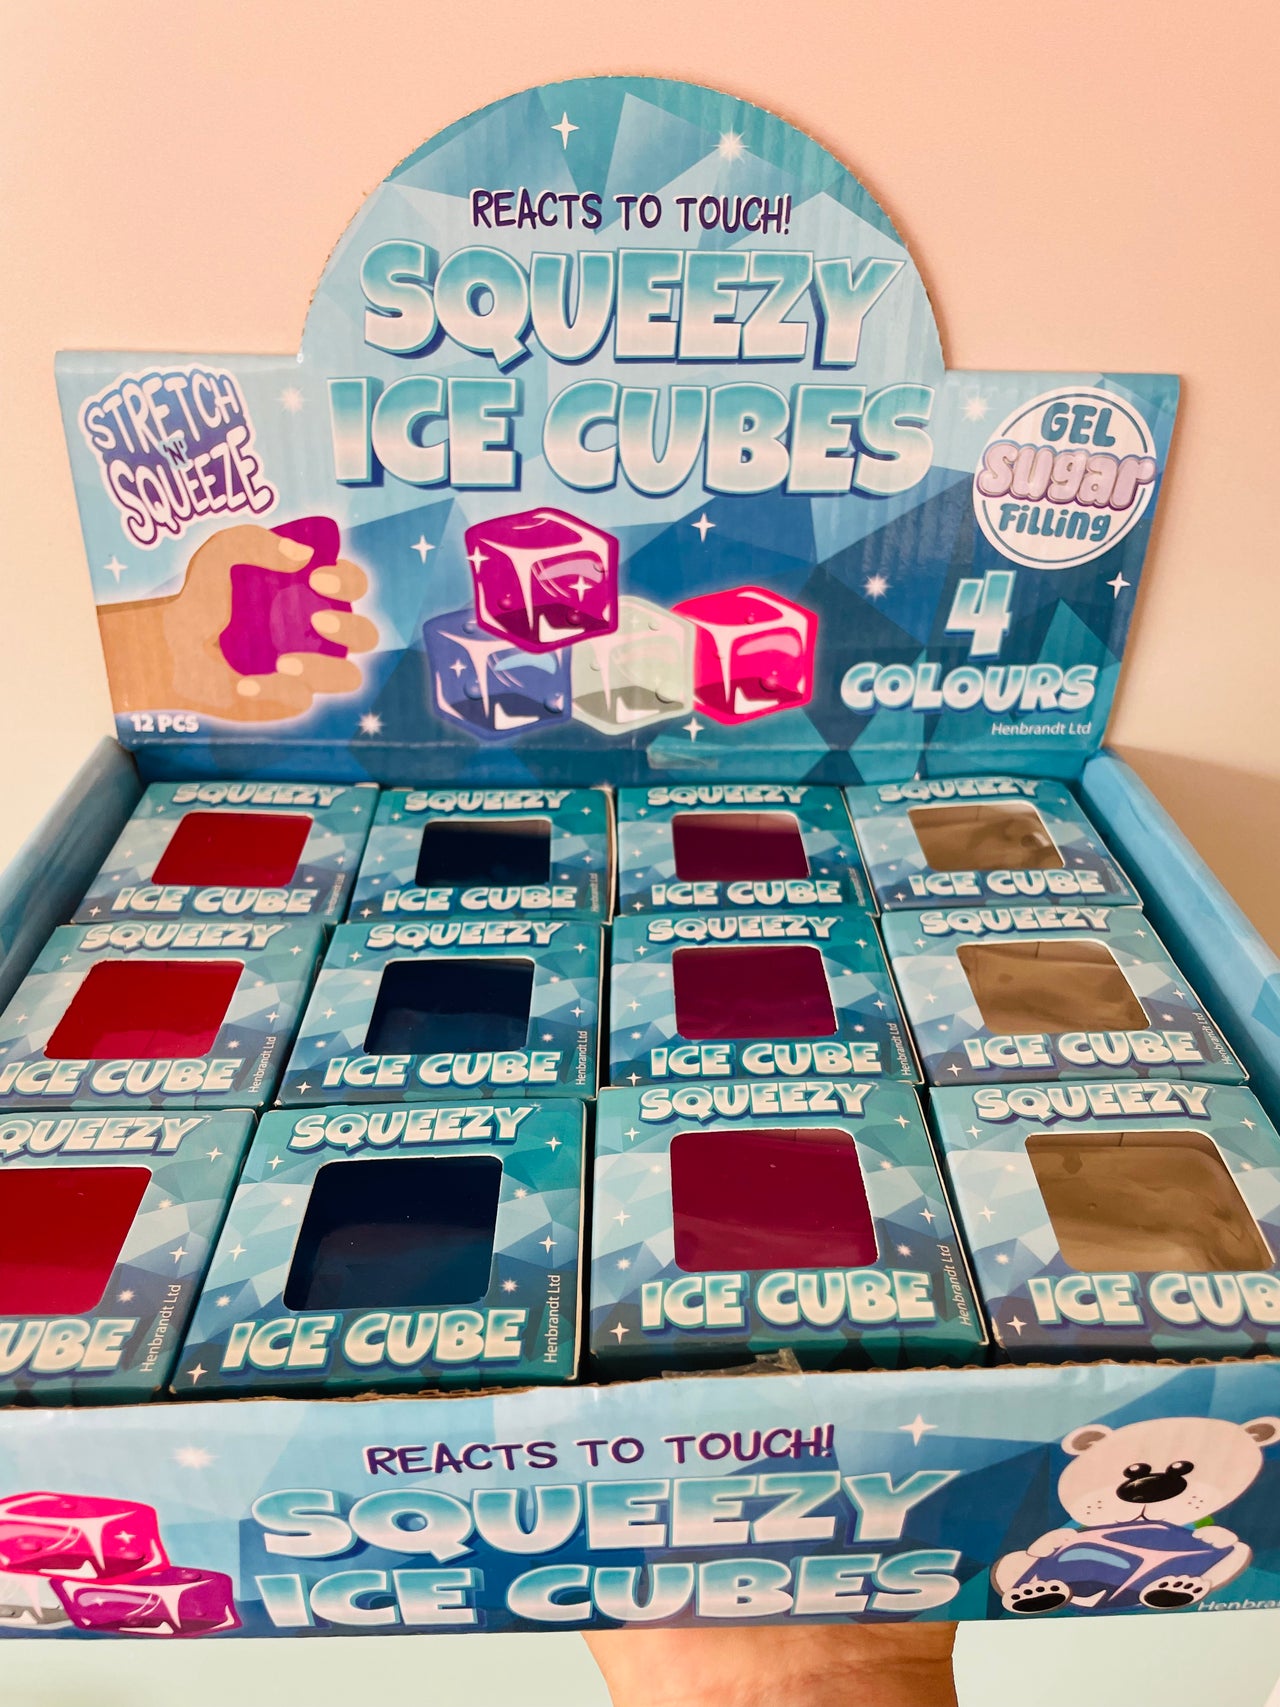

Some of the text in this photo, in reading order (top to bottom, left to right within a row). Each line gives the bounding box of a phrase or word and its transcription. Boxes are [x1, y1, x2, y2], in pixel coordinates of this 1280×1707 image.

[472, 187, 792, 235] REACTS TO TOUCH!
[360, 238, 907, 372] SQUEEZY
[84, 368, 246, 454] STRETCH
[1040, 402, 1116, 447] GEL
[326, 374, 936, 498] ICE CUBES
[108, 425, 274, 545] SQUEEZE
[944, 570, 1016, 658] 4
[840, 662, 1098, 714] COLOURS
[130, 716, 199, 733] 12 PCS
[991, 722, 1092, 736] Henbrandt Ltd
[172, 783, 345, 806] SQUEEZY
[404, 790, 573, 813] SQUEEZY
[646, 784, 809, 806] SQUEEZY
[877, 778, 1042, 803] SQUEEZY
[110, 886, 190, 914] ICE
[192, 887, 319, 914] CUBE
[380, 887, 452, 914] ICE
[460, 886, 578, 912] CUBE
[650, 881, 720, 906] ICE
[726, 879, 843, 906] CUBE
[907, 870, 982, 898] ICE
[985, 869, 1106, 897] CUBE
[77, 922, 287, 953] SQUEEZY
[364, 921, 564, 950] SQUEEZY
[647, 915, 839, 944] SQUEEZY
[918, 907, 1112, 936] SQUEEZY
[248, 1036, 277, 1093] Henbrandt Ltd
[321, 1050, 563, 1091] ICE CUBE
[575, 1030, 588, 1086] Henbrandt Ltd
[649, 1041, 884, 1079] ICE CUBE
[886, 1022, 912, 1076] Henbrandt Ltd
[962, 1031, 1206, 1071] ICE CUBE
[0, 1057, 247, 1098] ICE CUBE
[638, 1080, 874, 1123] SQUEEZY
[973, 1082, 1212, 1126] SQUEEZY
[0, 1115, 204, 1160] QUEEZY
[287, 1105, 535, 1154] SQUEEZY
[641, 1270, 937, 1332] ICE CUBE
[936, 1244, 973, 1327] Henbrandt Ltd
[1027, 1271, 1280, 1332] ICE CUB
[139, 1284, 181, 1372] Henbrandt Ltd
[543, 1274, 561, 1363] Henbrandt Ltd
[0, 1316, 139, 1379] UBE
[219, 1308, 530, 1376] ICE CUBE
[366, 1423, 836, 1475] REACTS TO TOUCH!
[251, 1470, 963, 1563] SQUEEZY
[255, 1550, 963, 1628] ICE CUBES
[1197, 1598, 1280, 1612] Henbra
